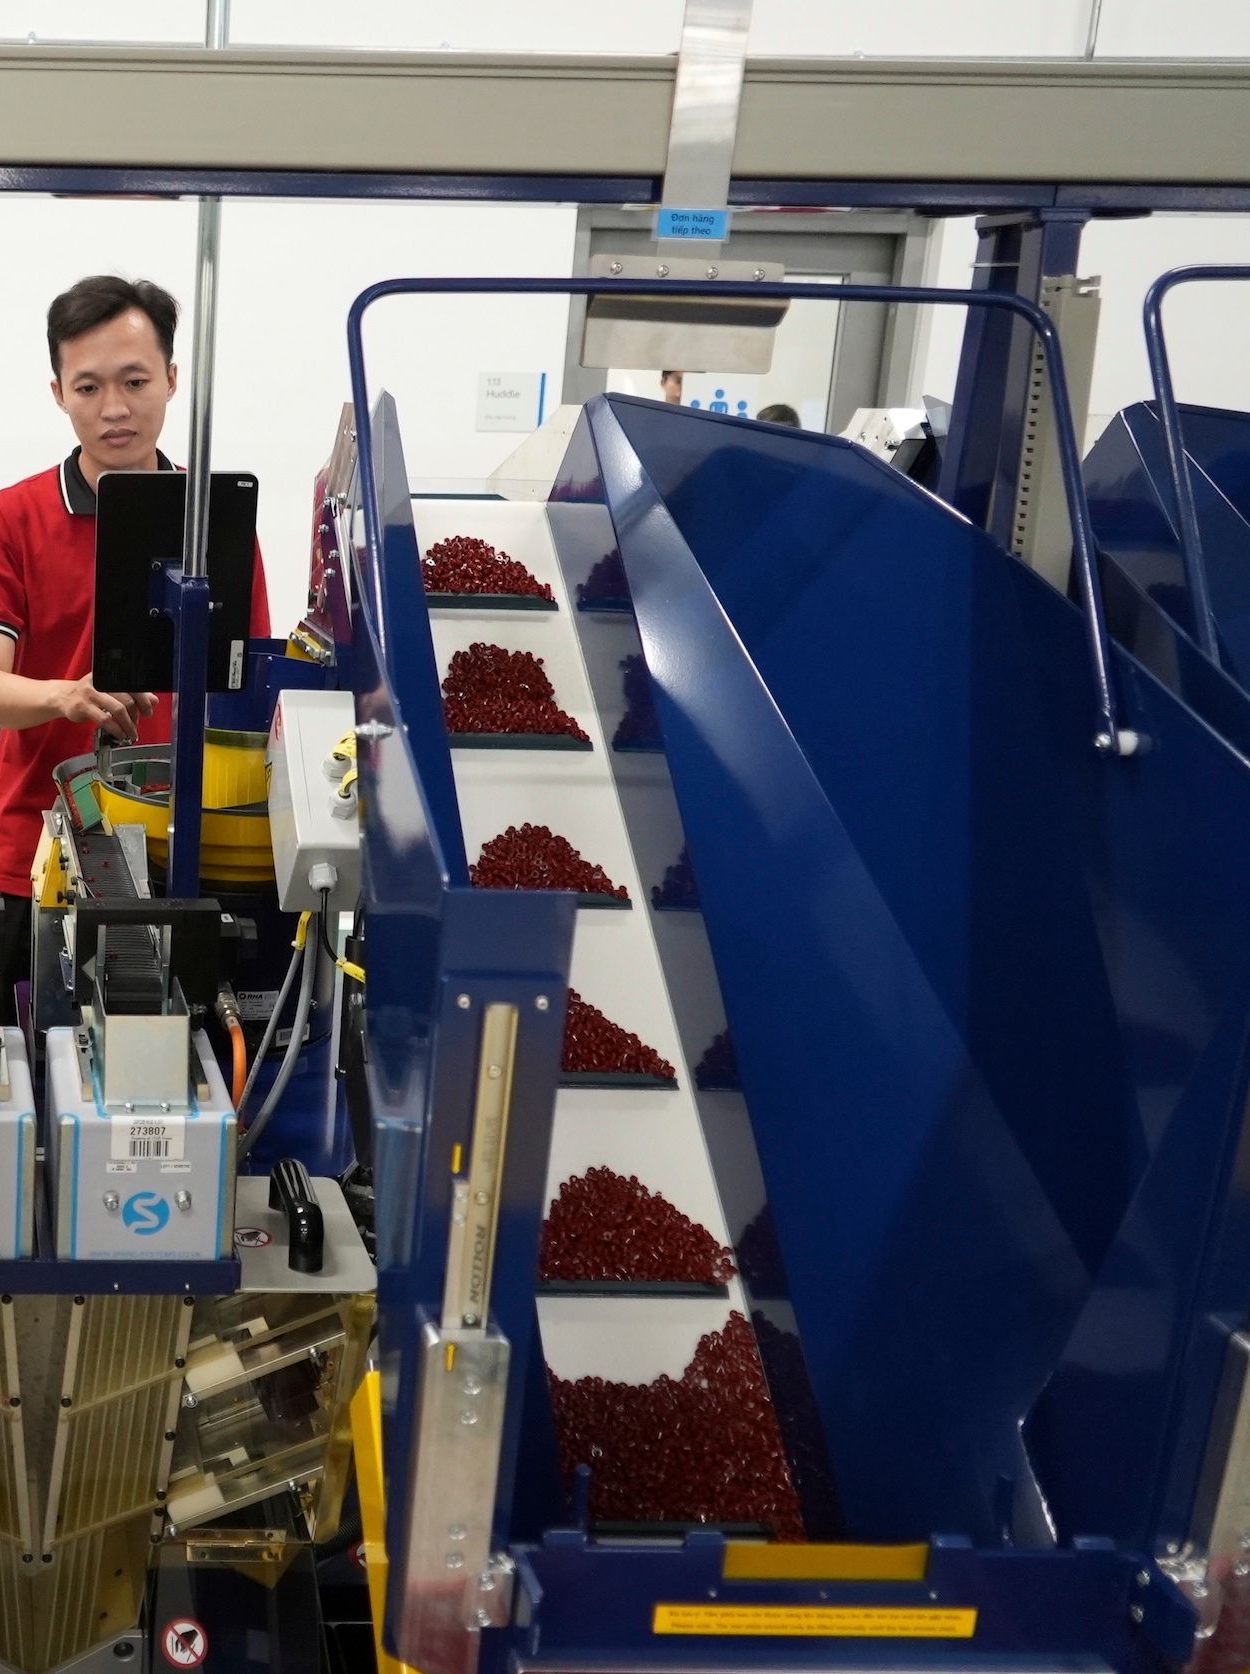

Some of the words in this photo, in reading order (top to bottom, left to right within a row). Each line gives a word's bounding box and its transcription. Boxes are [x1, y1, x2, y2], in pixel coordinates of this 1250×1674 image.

[671, 213, 690, 222] Đơn
[692, 214, 715, 225] hàng
[672, 225, 689, 235] tiếp
[691, 226, 711, 235] theo
[486, 390, 521, 399] Huddle
[130, 1126, 166, 1136] 273807
[469, 1225, 487, 1304] ROLLON
